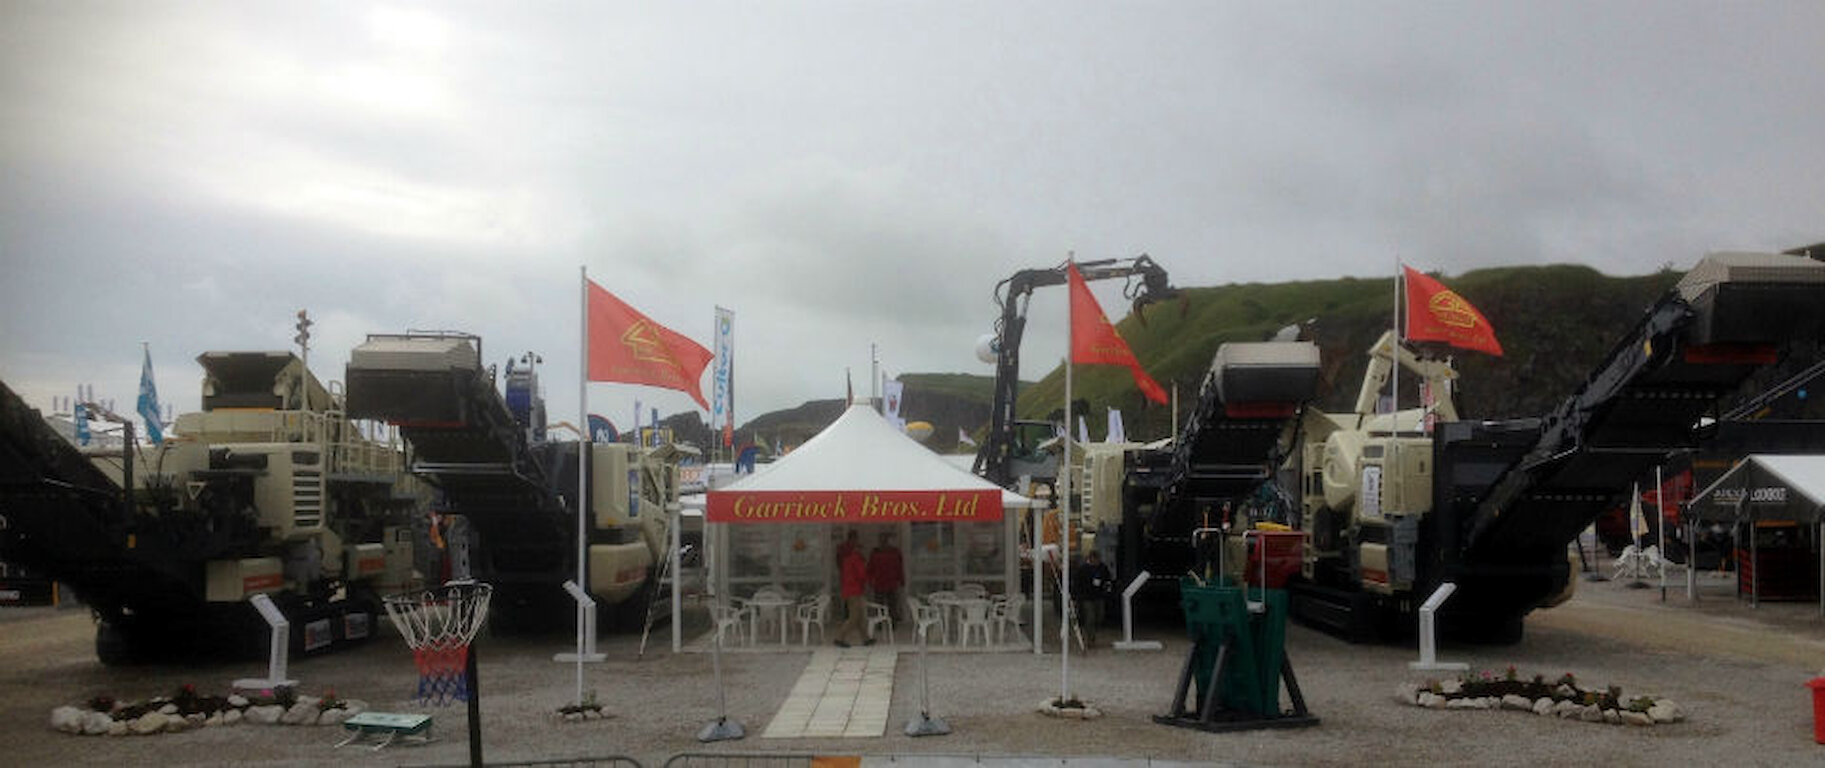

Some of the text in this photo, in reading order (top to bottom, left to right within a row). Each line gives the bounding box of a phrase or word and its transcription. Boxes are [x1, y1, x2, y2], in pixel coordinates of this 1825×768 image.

[734, 493, 979, 518] Garriock Bros. Ltd
